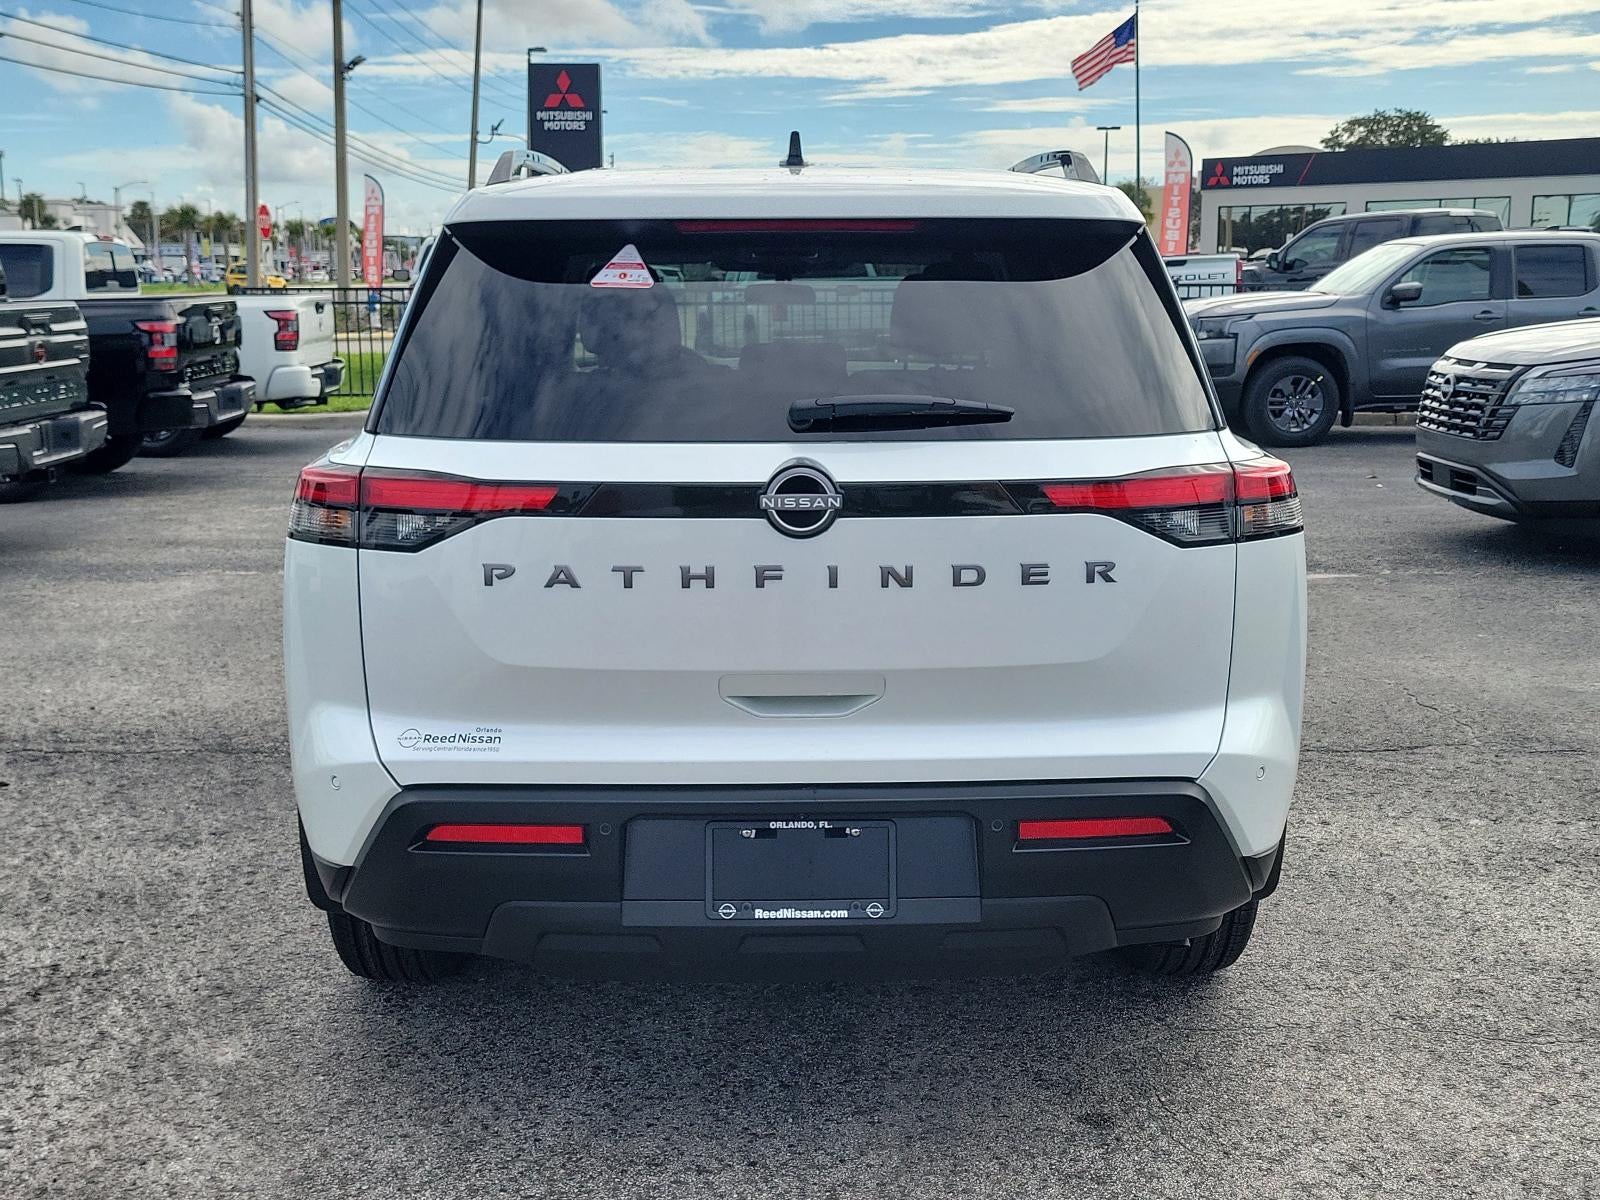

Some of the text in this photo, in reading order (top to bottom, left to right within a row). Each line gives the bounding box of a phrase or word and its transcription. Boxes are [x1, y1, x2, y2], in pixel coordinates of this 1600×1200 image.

[536, 110, 593, 121] MITSUBISHI
[543, 121, 586, 131] MOTORS
[1232, 163, 1284, 176] MITSUBISHI
[1232, 175, 1271, 186] MOTORS
[762, 497, 841, 508] NISSAN
[482, 560, 1118, 589] PATHFINDER
[769, 821, 833, 830] ORLANDO, FL.
[754, 908, 848, 919] ReedNissan.com
